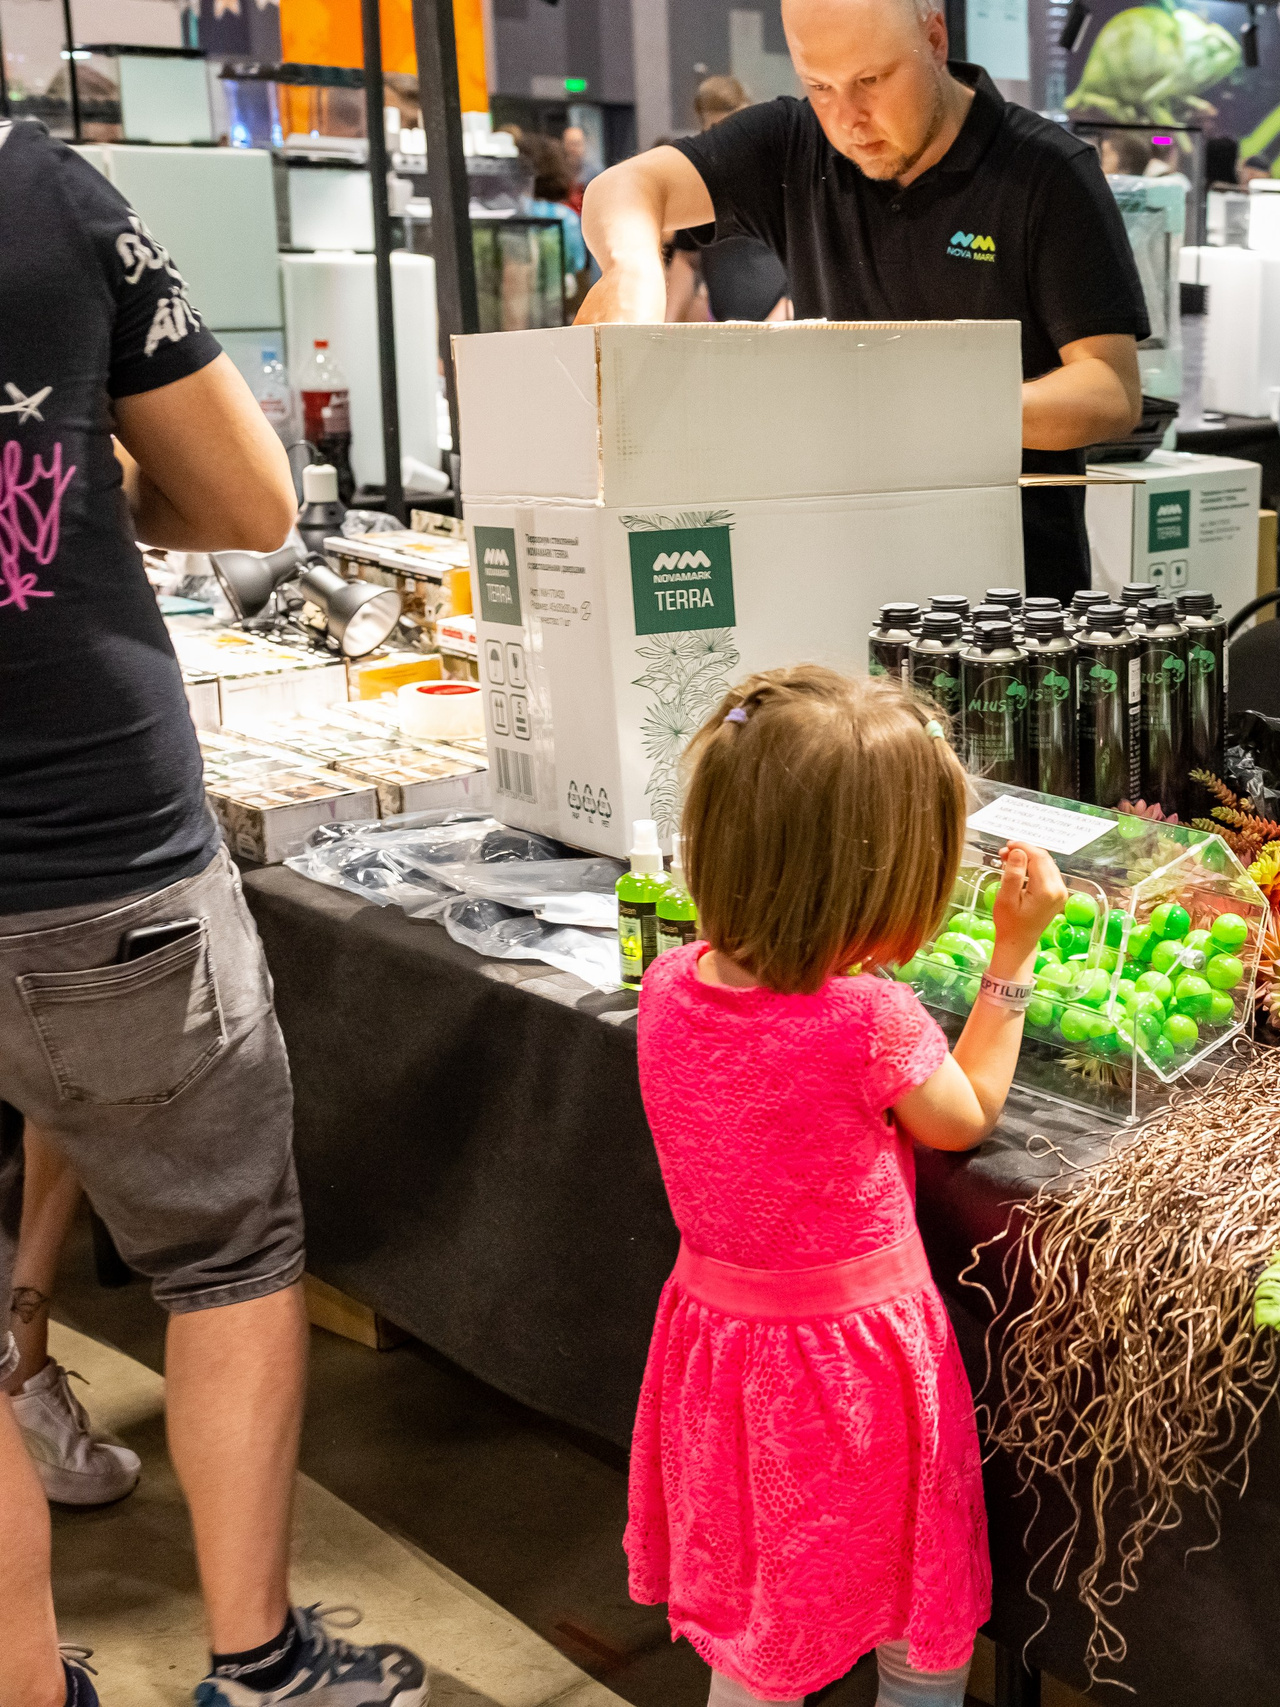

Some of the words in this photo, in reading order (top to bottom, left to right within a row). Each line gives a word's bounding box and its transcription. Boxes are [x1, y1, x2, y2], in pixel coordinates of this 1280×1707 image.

[946, 246, 972, 259] NOVA
[973, 252, 996, 263] MARK
[653, 571, 712, 584] NOVAMARK
[486, 583, 513, 605] TERRA
[654, 588, 714, 611] TERRA
[968, 699, 1007, 713] MIUS
[981, 977, 1033, 998] EPTILIUM
